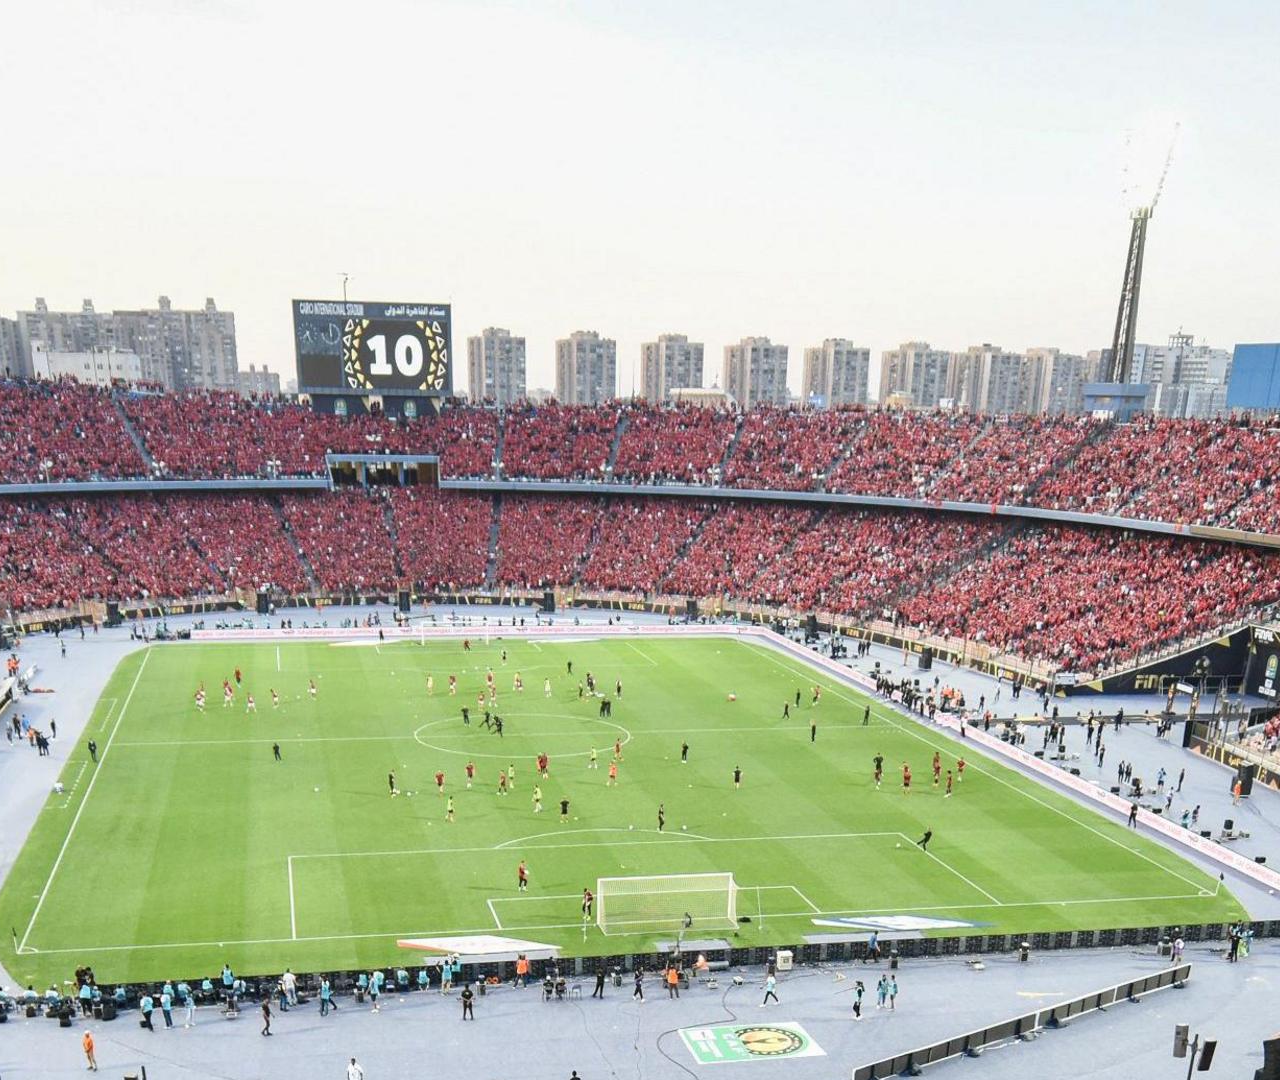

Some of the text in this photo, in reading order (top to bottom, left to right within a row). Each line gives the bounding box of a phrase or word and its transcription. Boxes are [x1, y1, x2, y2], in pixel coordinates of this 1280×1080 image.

[299, 303, 364, 316] CAIRO INTERNATIONAL STADIUM
[366, 334, 423, 377] 10
